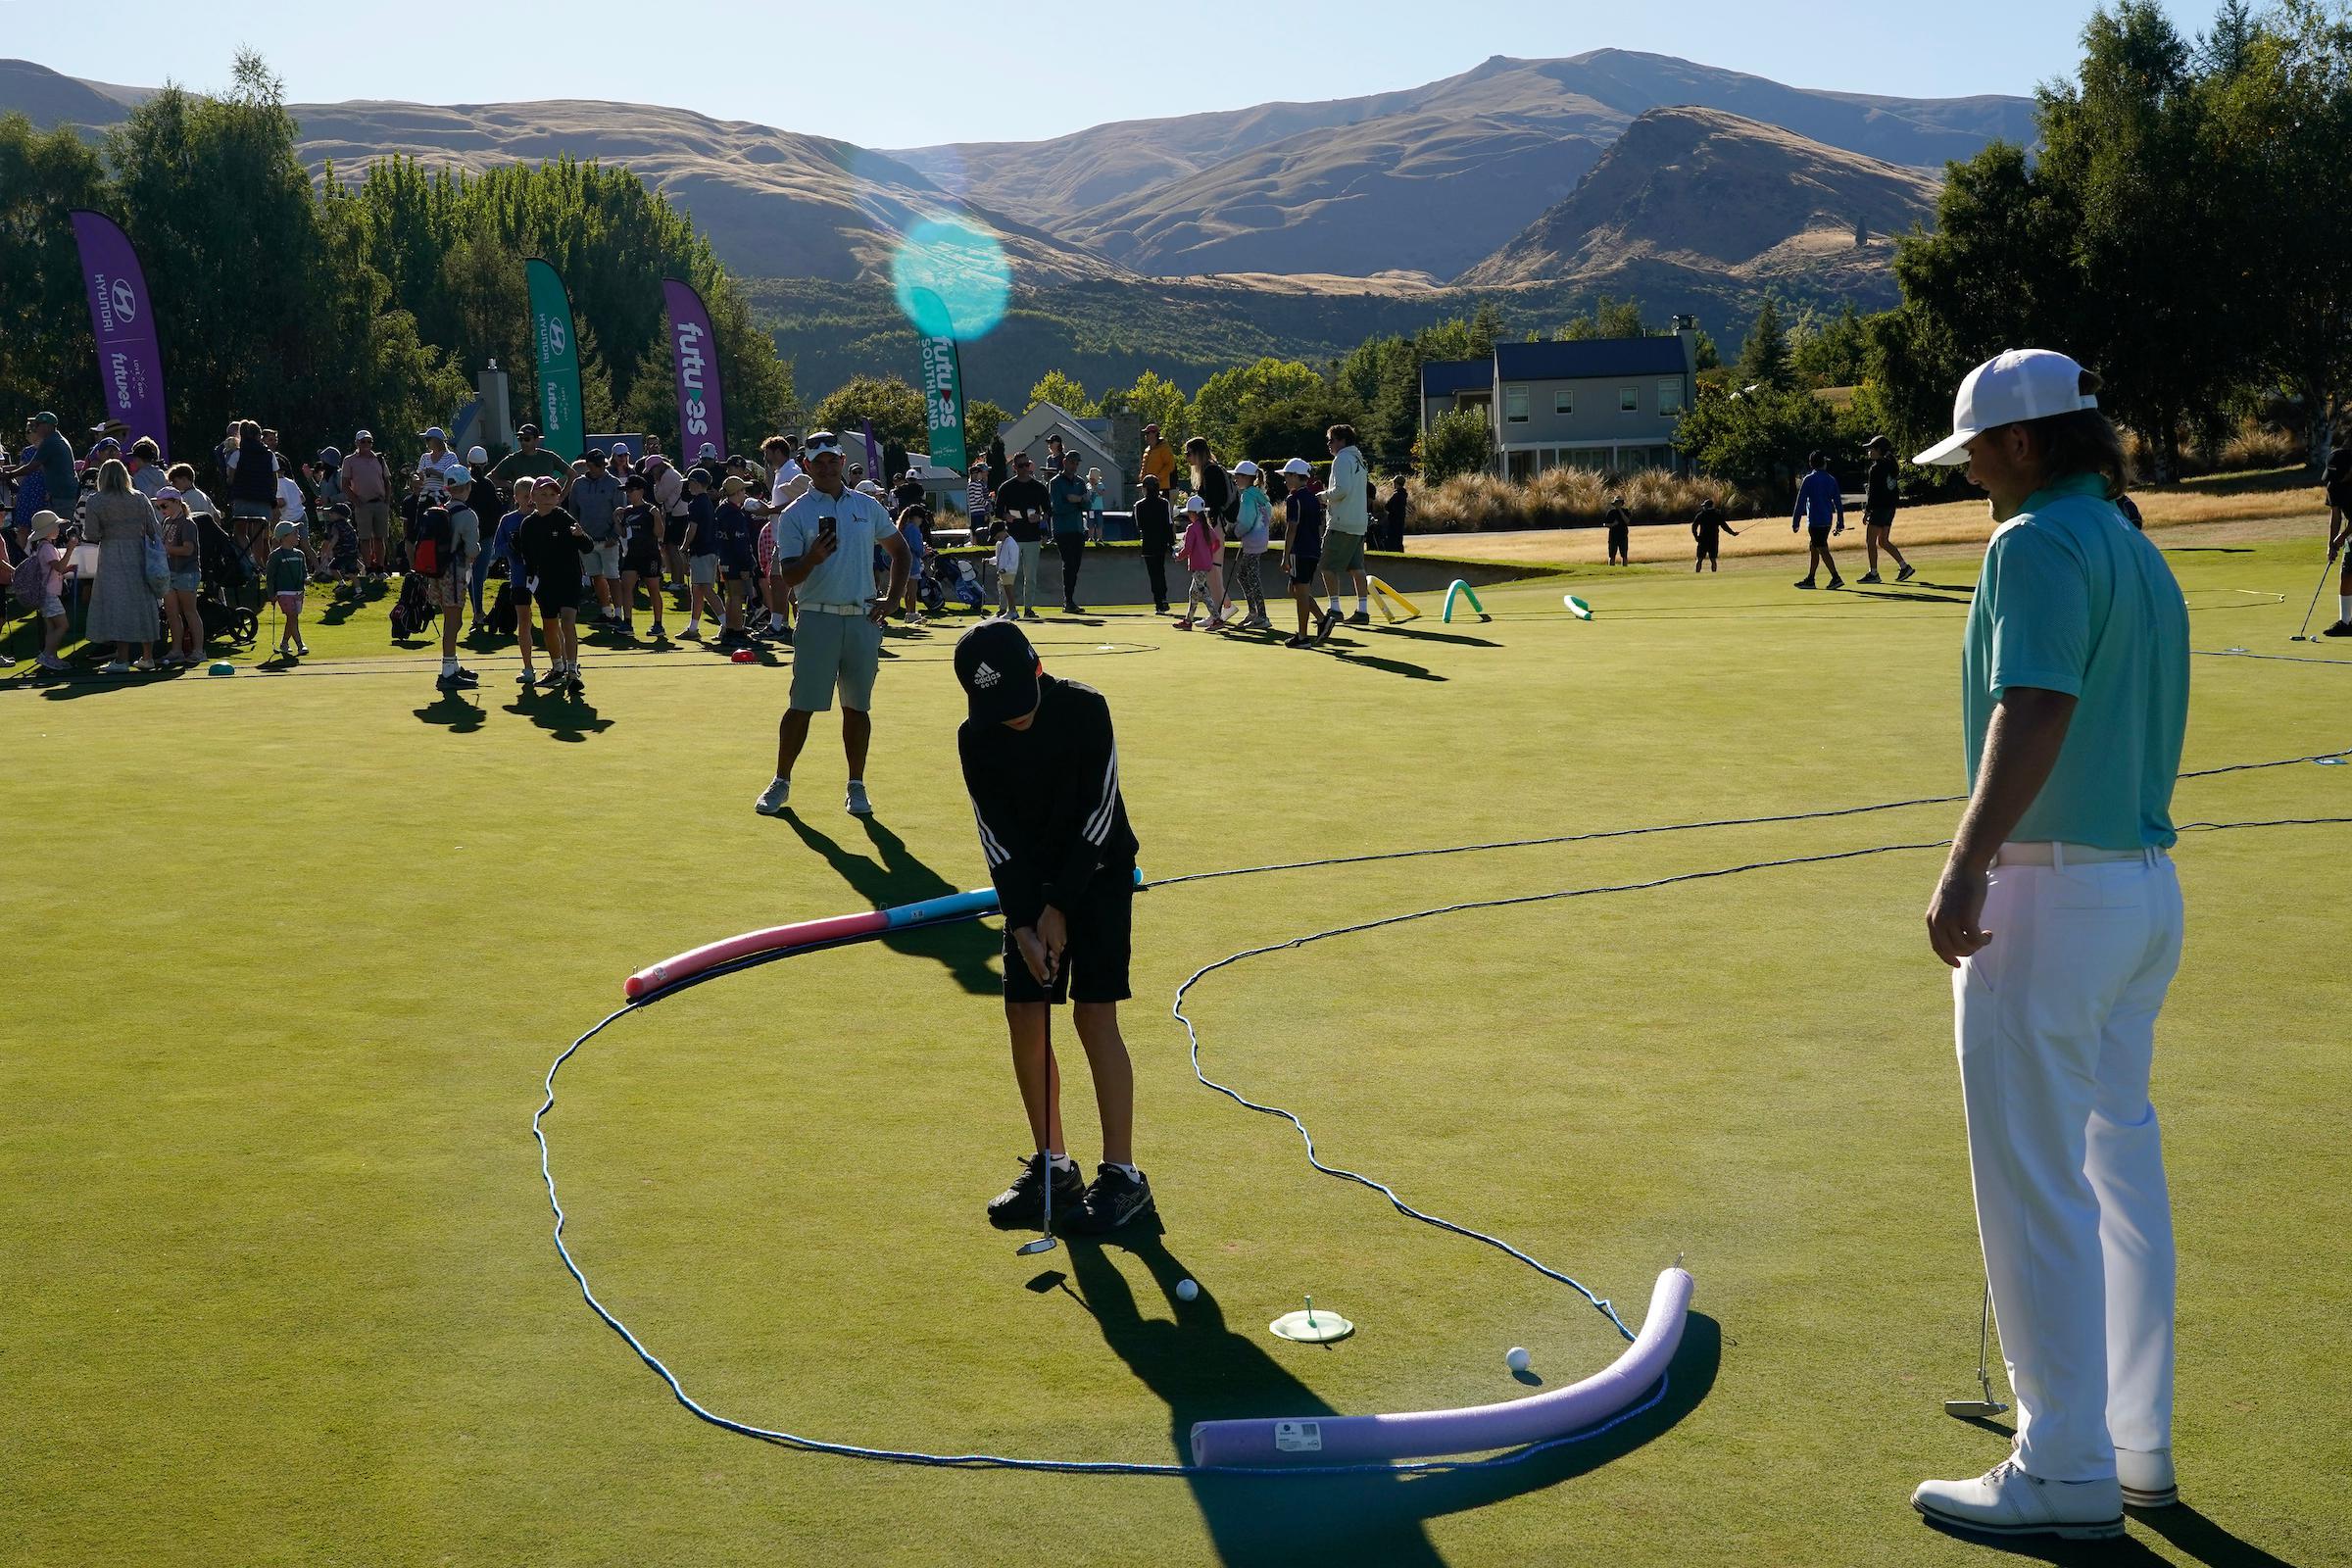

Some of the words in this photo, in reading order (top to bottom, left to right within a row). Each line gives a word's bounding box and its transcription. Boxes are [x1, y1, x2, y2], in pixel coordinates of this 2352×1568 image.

[94, 273, 115, 332] HYUNDAI
[539, 314, 550, 364] HYUNDAI
[920, 337, 940, 431] SOUTHLAND
[974, 671, 1002, 685] adidas
[980, 679, 999, 689] GOLF
